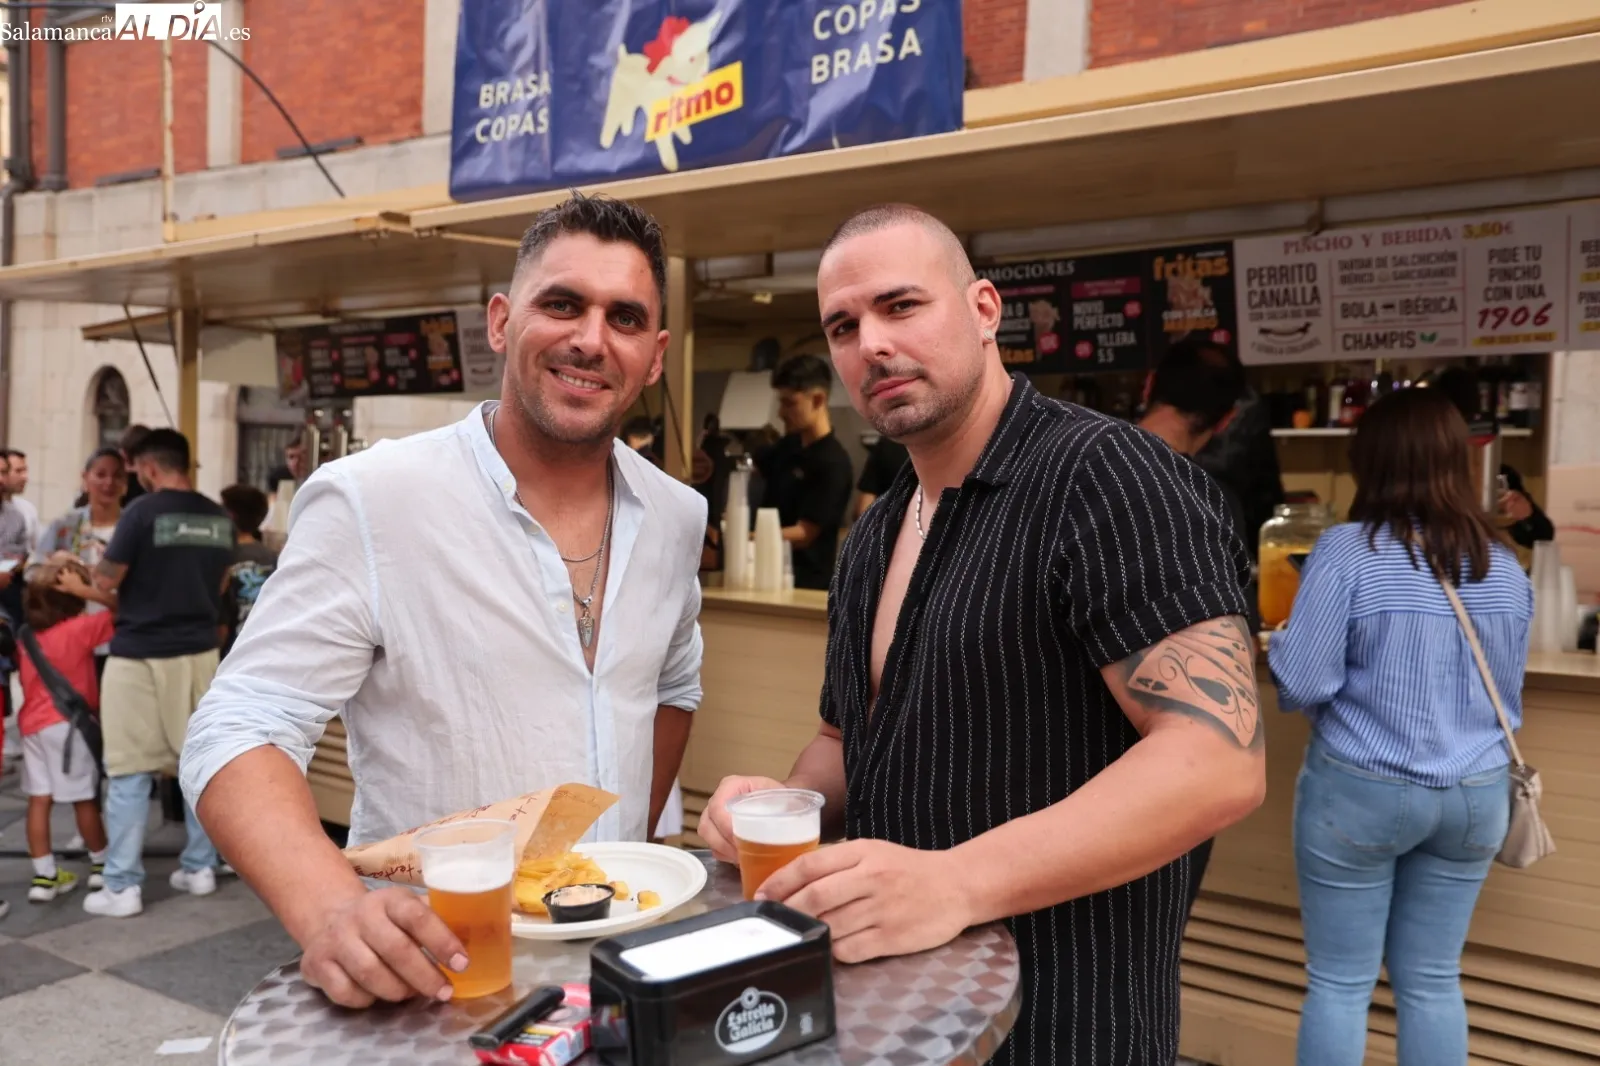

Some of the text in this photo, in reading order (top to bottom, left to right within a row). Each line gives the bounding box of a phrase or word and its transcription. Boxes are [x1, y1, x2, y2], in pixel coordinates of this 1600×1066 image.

[811, 27, 923, 85] BRASA
[478, 70, 552, 109] BRASA
[654, 81, 734, 134] ritmo
[475, 106, 550, 144] COPAS
[1283, 235, 1353, 255] PINCHO
[1362, 232, 1373, 249] Y
[1488, 244, 1543, 264] PIDE TU
[976, 260, 1076, 281] OMOCIONES
[1153, 253, 1229, 281] fritas
[1246, 262, 1318, 288] PERRITO
[1488, 265, 1542, 282] PINCHO
[1247, 285, 1322, 310] CANALLA
[1483, 284, 1547, 302] CON UNA
[1340, 301, 1378, 319] BOLA
[1399, 295, 1458, 315] IBÉRICA
[1477, 302, 1554, 330] 1906
[1342, 330, 1417, 351] CHAMPIS
[727, 1002, 776, 1028] Estrella
[729, 1018, 775, 1042] Galicia
